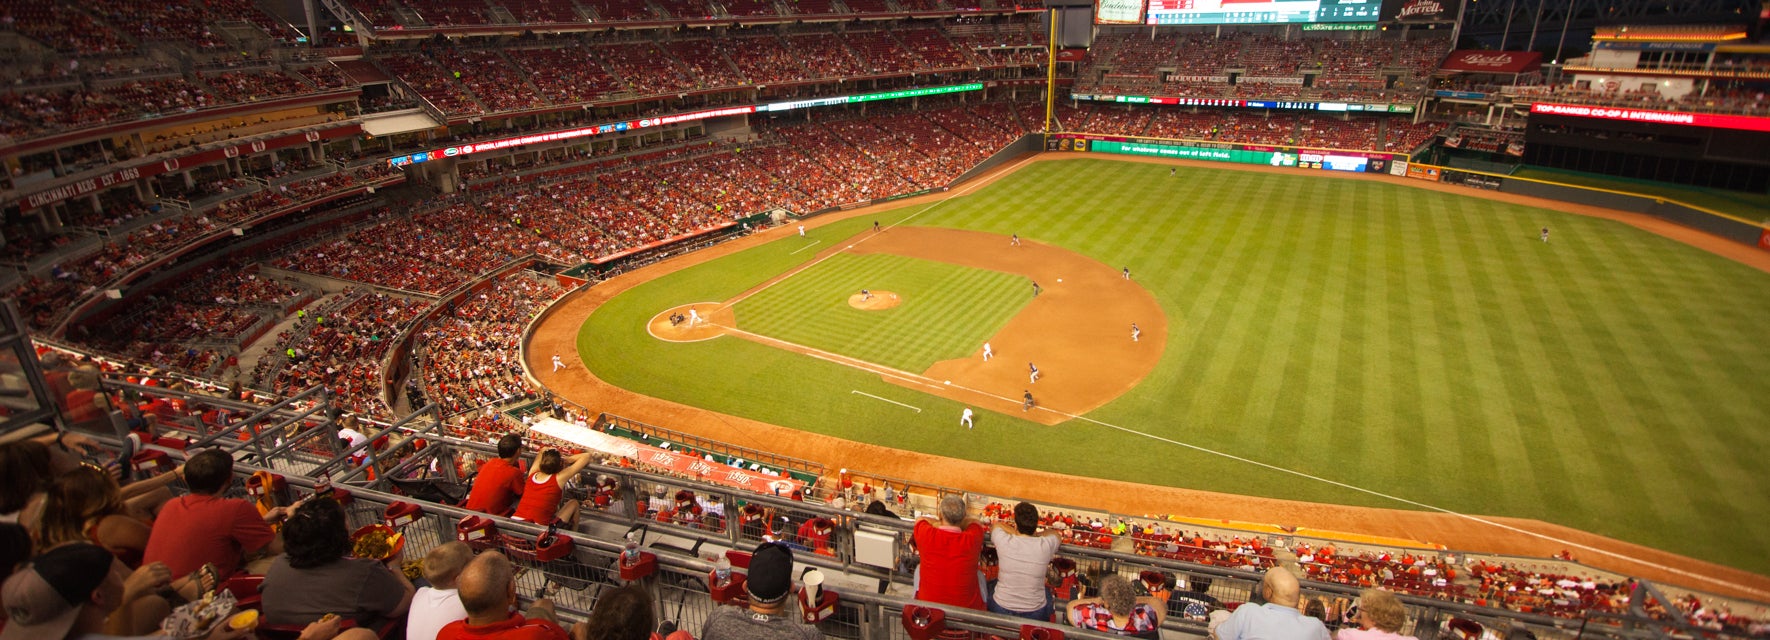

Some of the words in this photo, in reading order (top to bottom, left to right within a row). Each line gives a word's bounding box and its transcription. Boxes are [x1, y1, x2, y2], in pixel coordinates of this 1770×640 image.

[1395, 4, 1440, 19] Morrell
[1460, 53, 1512, 65] Reds
[1536, 104, 1590, 116] TOP-RANKED
[1591, 108, 1621, 118] CO-OP
[1621, 110, 1629, 118] &
[1629, 111, 1694, 124] INTERNSHIPS
[27, 188, 76, 208] CINCINNATI
[77, 179, 97, 193] REDS
[102, 174, 120, 187] EST.
[120, 168, 141, 182] 1869
[654, 452, 674, 466] 1975
[729, 470, 749, 484] 1990
